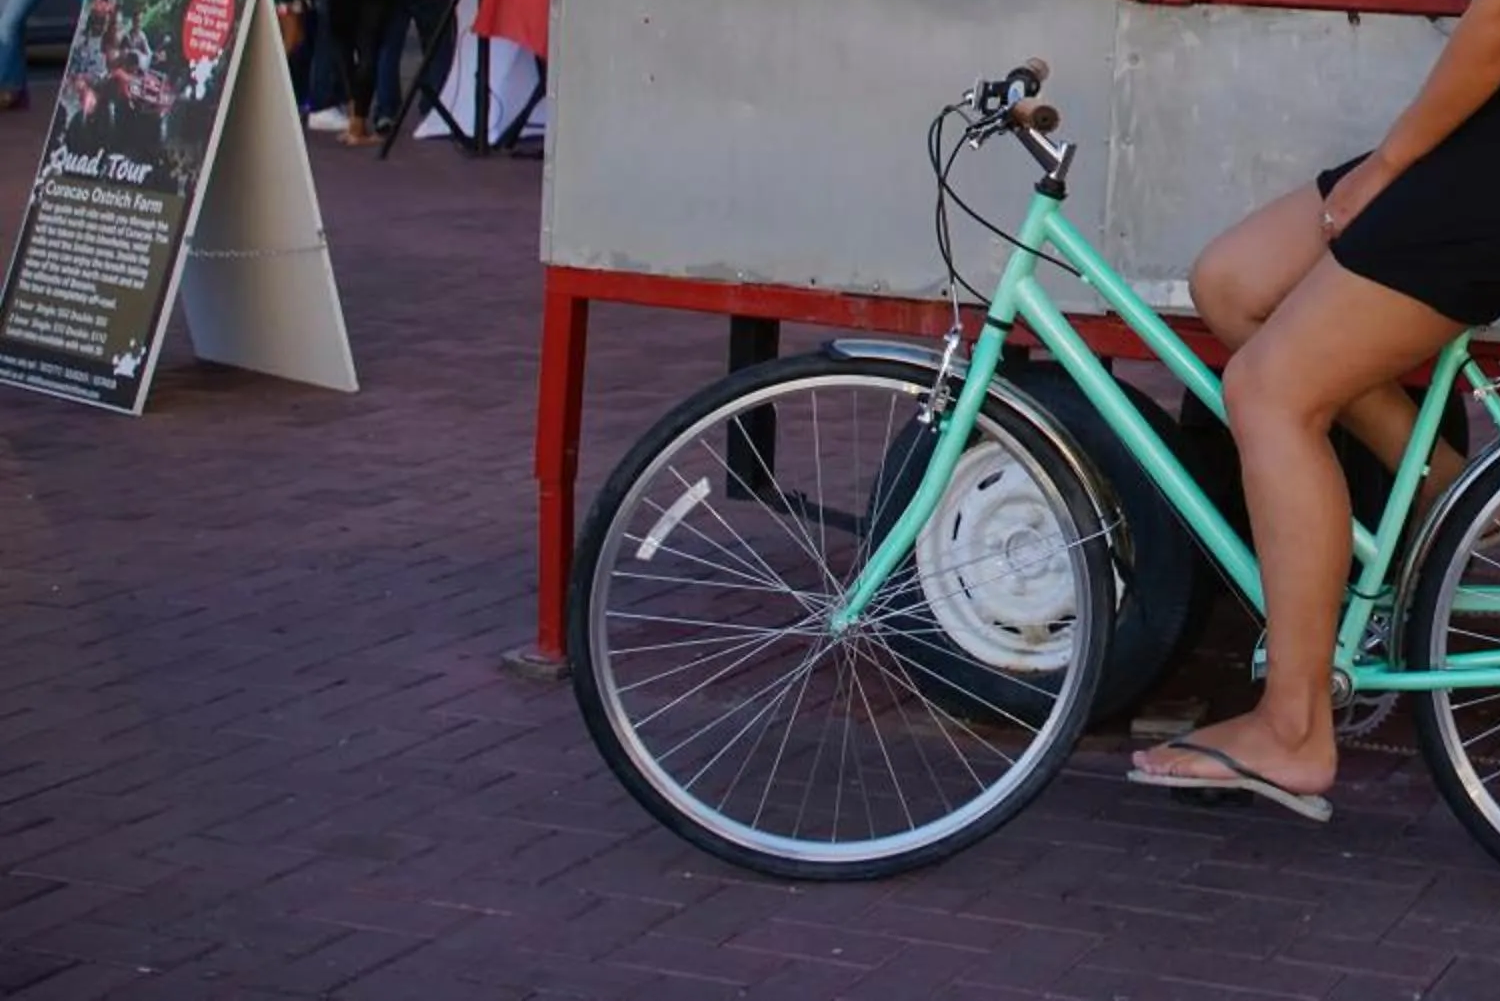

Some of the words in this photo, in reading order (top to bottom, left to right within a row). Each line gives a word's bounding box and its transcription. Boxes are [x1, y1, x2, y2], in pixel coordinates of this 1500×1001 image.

[43, 144, 105, 177] Quad
[107, 153, 154, 184] Tour
[91, 187, 131, 209] Ostrich
[133, 194, 164, 214] Farm
